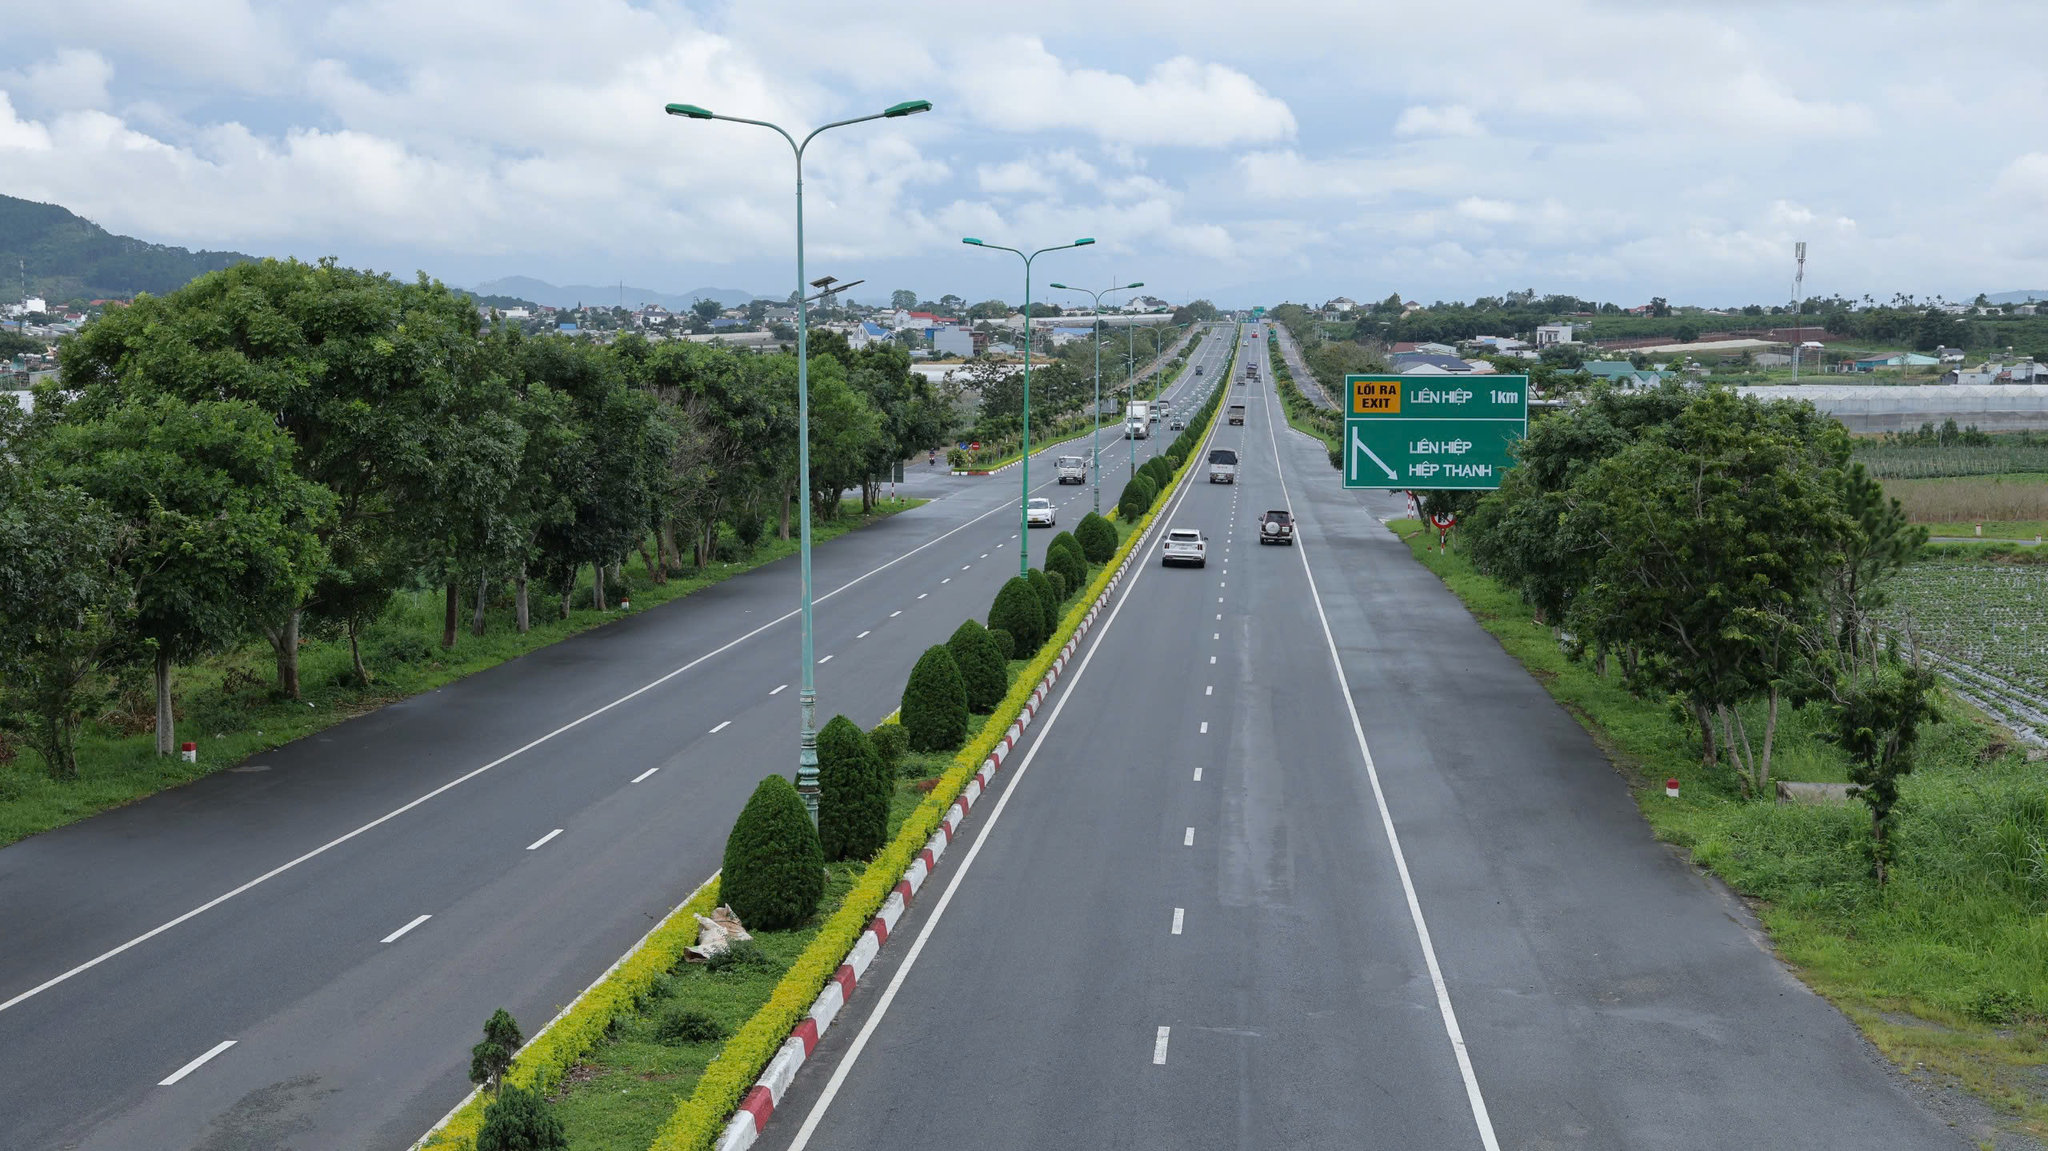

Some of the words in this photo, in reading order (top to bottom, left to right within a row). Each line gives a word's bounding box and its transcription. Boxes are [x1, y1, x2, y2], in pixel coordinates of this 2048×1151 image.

[1357, 382, 1375, 395] LỐI
[1379, 385, 1397, 395] RA
[1410, 387, 1440, 404] LIÊN
[1441, 387, 1473, 406] HIỆP
[1362, 398, 1391, 408] EXIT
[1409, 438, 1439, 454] LIÊN
[1441, 438, 1473, 456] HIỆP
[1408, 460, 1440, 479] HIỆP
[1442, 464, 1492, 479] THẠNH
